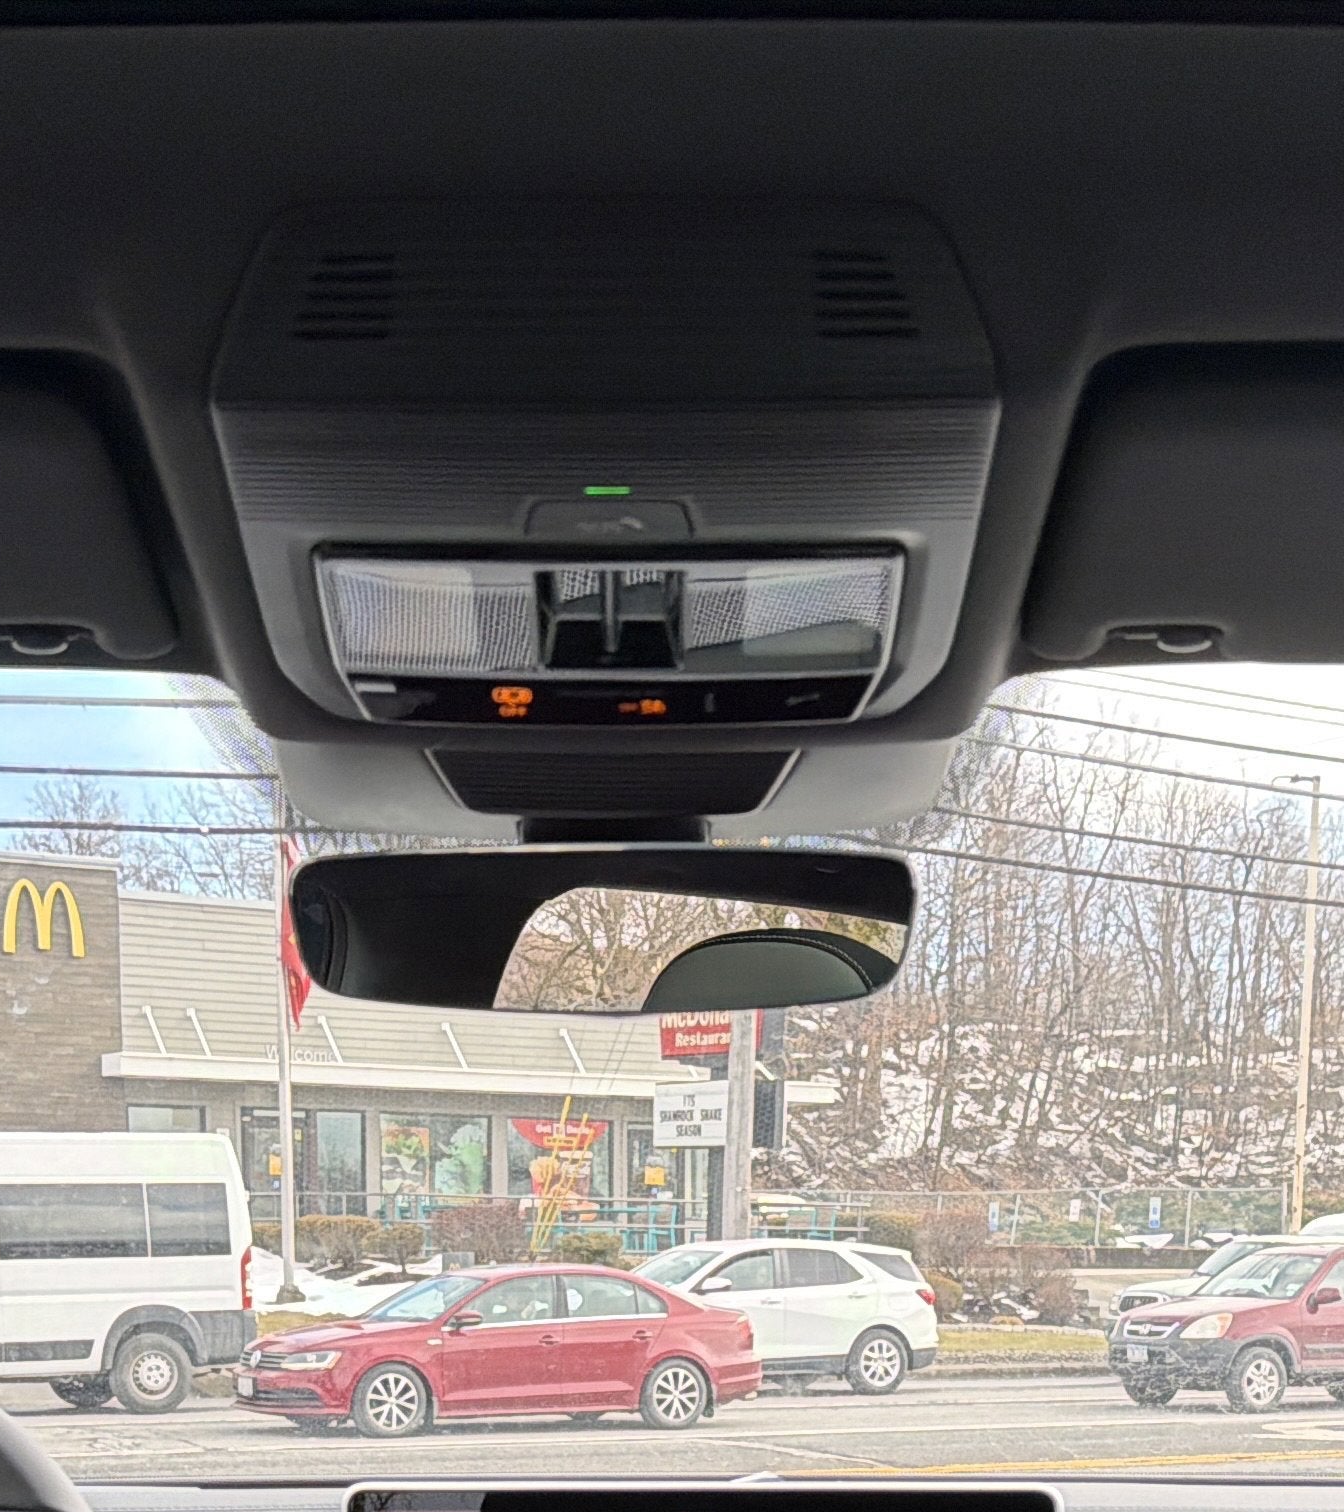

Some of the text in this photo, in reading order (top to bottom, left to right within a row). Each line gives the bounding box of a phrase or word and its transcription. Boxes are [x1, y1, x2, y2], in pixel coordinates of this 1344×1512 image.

[662, 1010, 731, 1028] McDona
[265, 1044, 339, 1063] Wlcome
[660, 1109, 722, 1123] SHAMROCK SHAKE
[676, 1125, 701, 1137] SEASON
